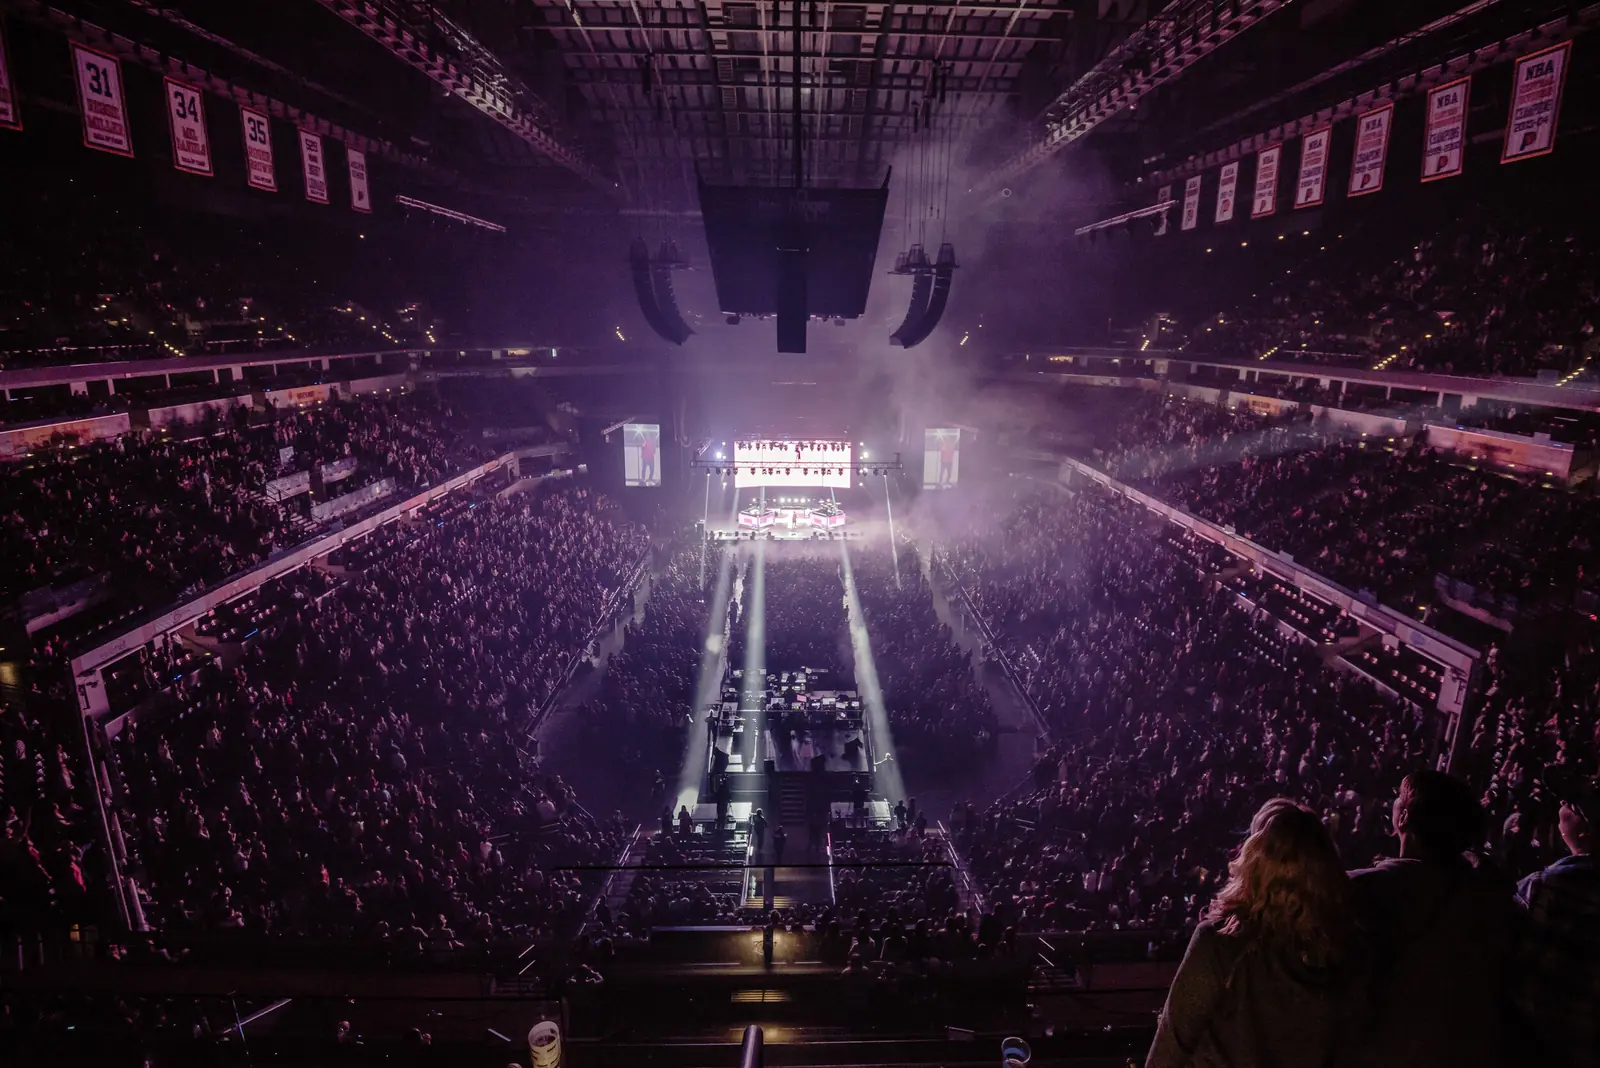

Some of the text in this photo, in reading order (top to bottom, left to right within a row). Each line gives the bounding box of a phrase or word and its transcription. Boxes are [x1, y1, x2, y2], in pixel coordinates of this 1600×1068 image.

[86, 62, 113, 98] 31
[1525, 59, 1554, 82] NBA
[174, 91, 199, 123] 34
[1436, 92, 1458, 109] NBA
[247, 117, 266, 145] 35
